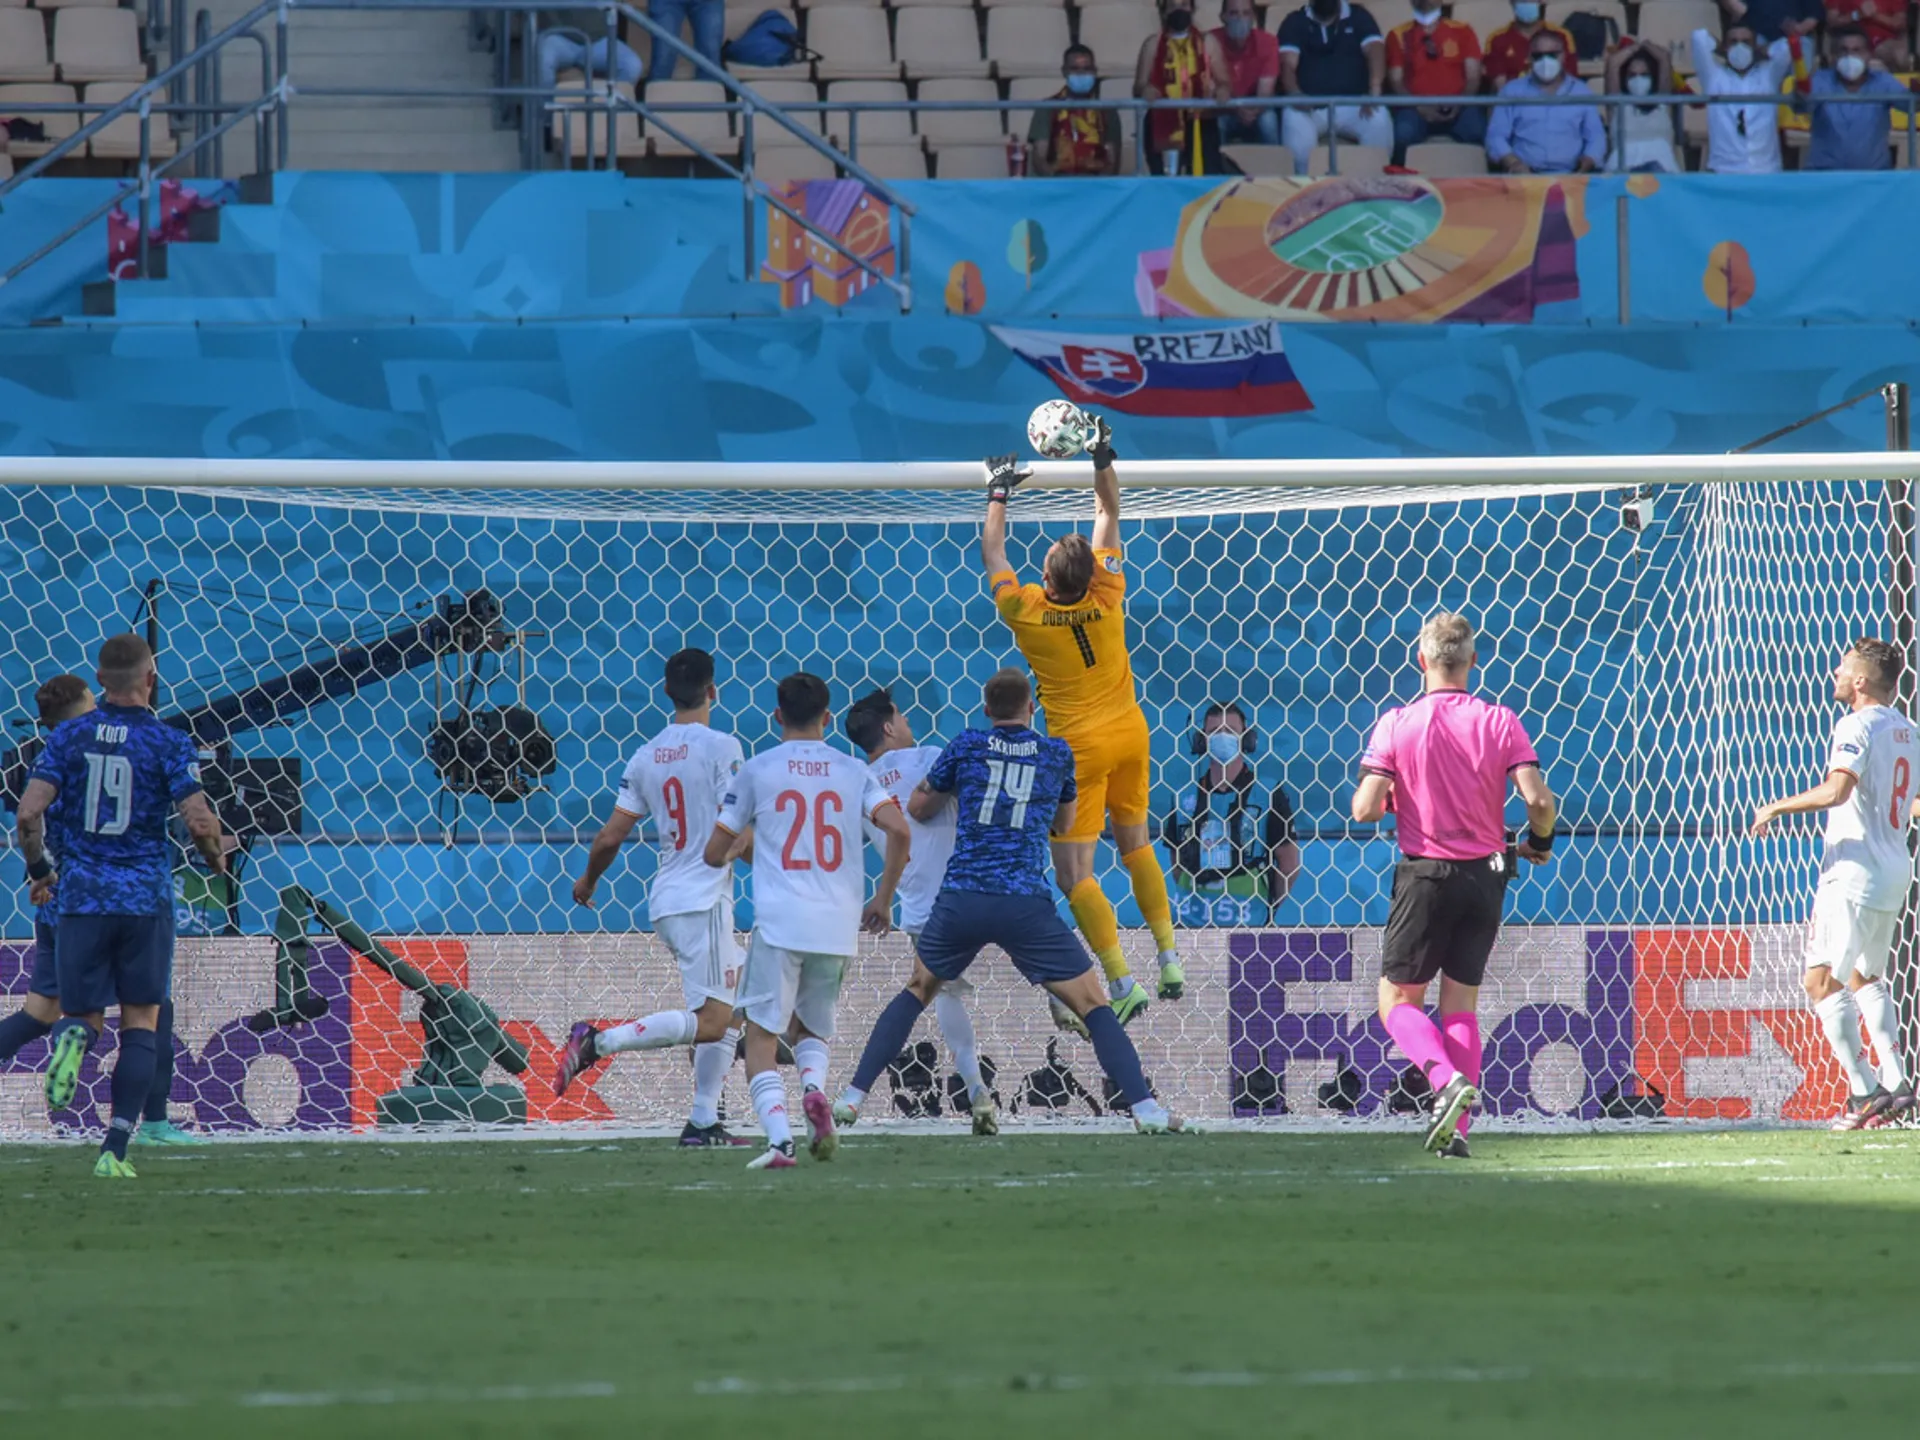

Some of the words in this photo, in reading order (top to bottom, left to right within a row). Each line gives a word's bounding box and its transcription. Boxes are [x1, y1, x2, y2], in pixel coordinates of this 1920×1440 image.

[1070, 623, 1096, 669] 1
[84, 752, 133, 835] 19
[788, 760, 831, 777] PEDRI
[978, 759, 1036, 829] 14
[1889, 756, 1910, 830] 8
[663, 776, 687, 851] 9
[775, 789, 843, 872] 26
